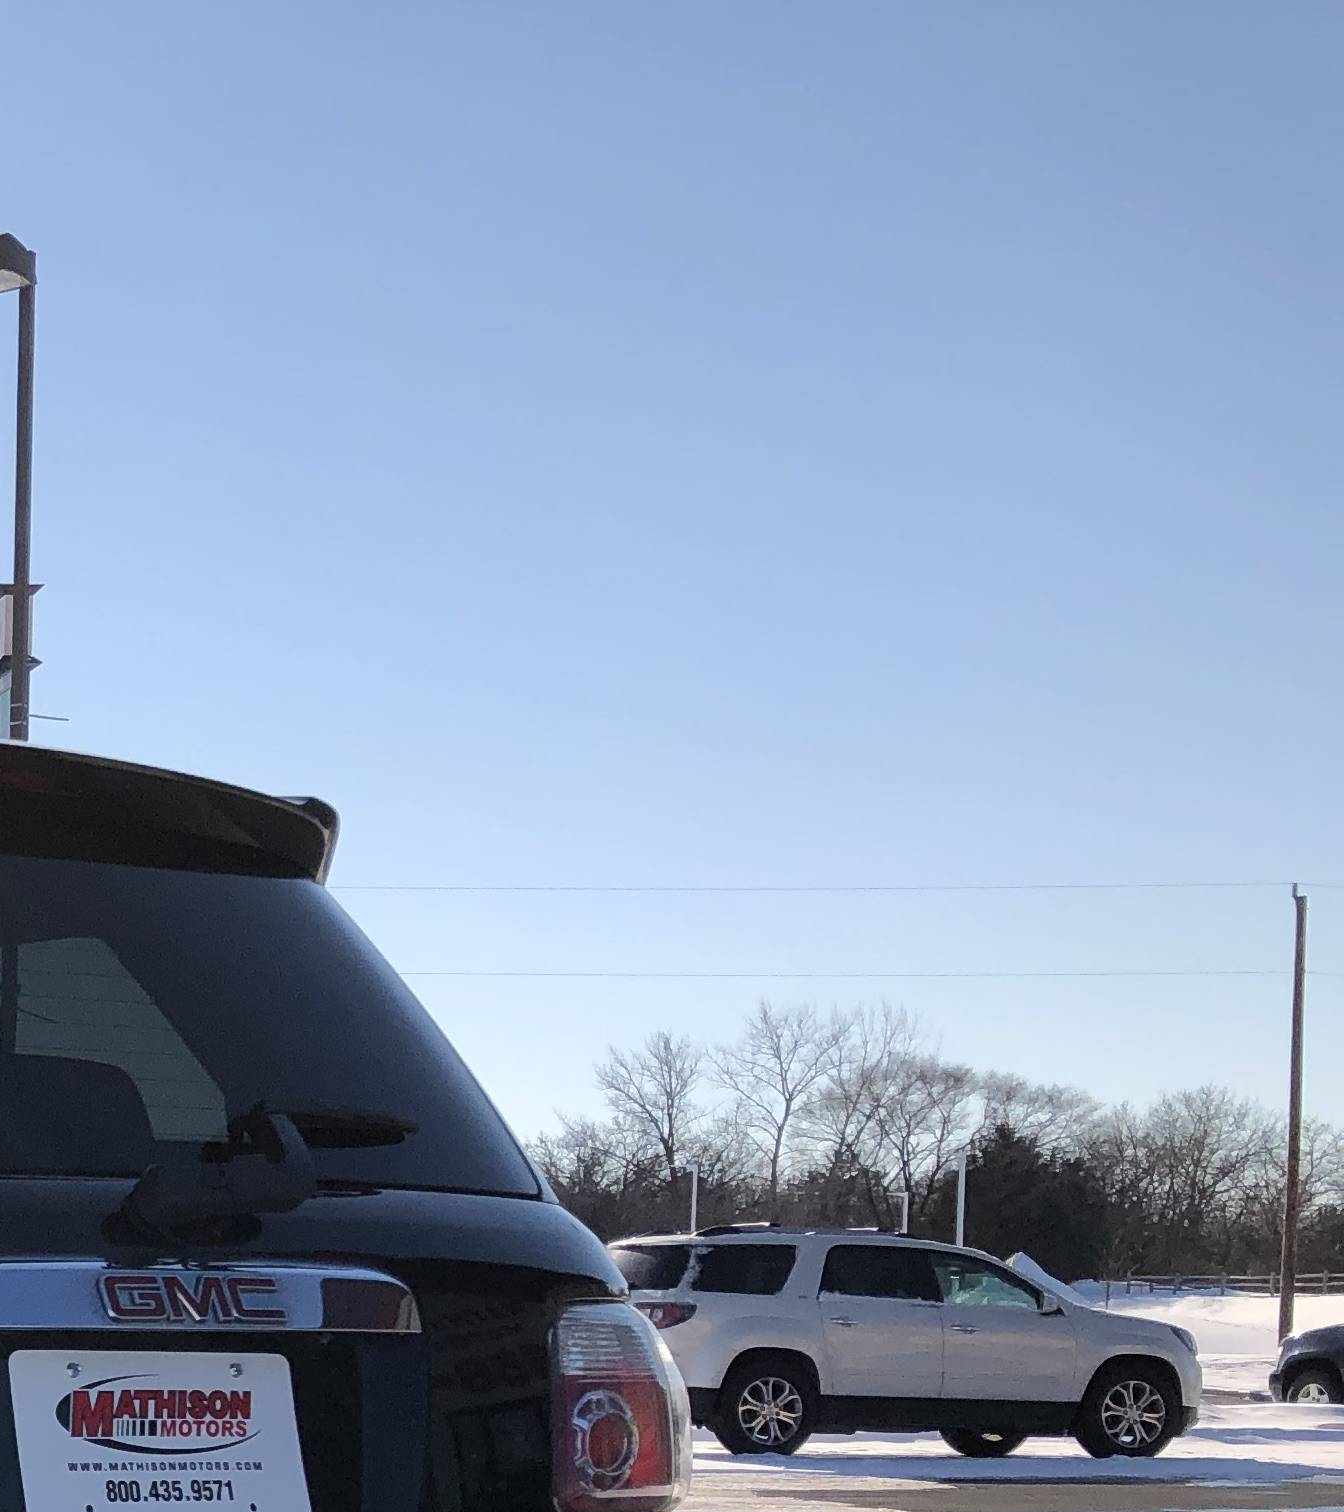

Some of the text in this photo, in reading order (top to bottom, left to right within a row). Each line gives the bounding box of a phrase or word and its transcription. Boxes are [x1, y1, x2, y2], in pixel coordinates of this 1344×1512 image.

[99, 1273, 288, 1321] GMC
[70, 1389, 252, 1438] MATHISON
[160, 1419, 248, 1438] MOTORS
[105, 1479, 235, 1502] 800.435.9571
